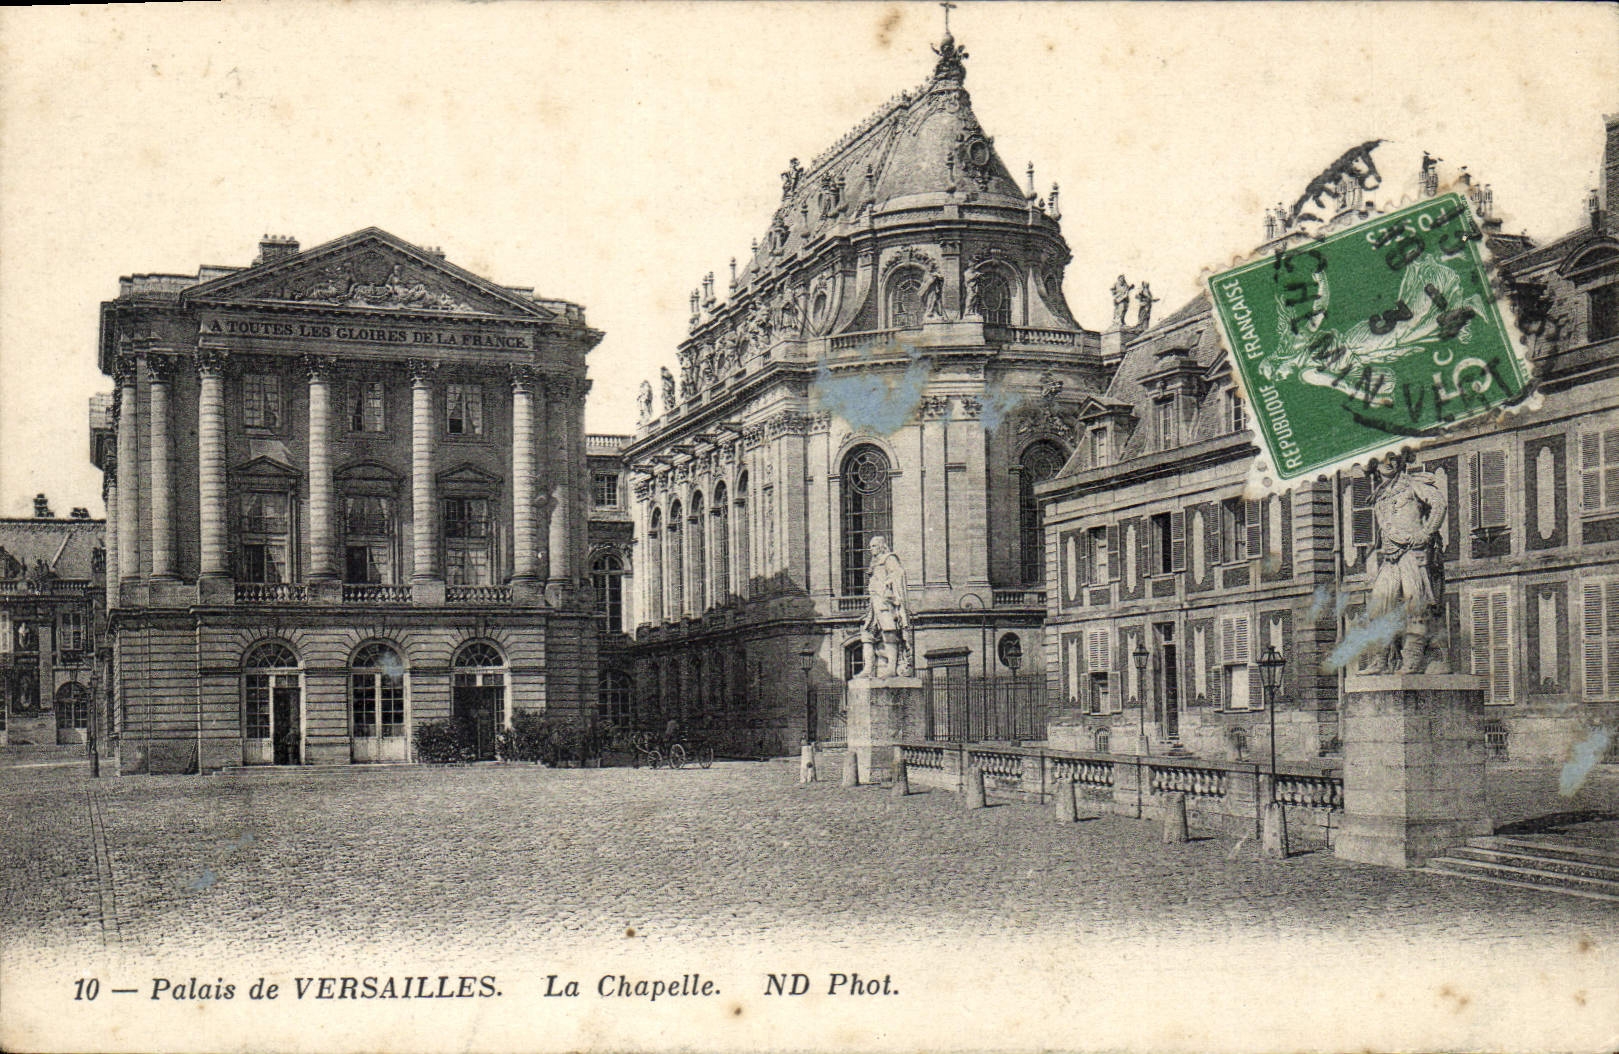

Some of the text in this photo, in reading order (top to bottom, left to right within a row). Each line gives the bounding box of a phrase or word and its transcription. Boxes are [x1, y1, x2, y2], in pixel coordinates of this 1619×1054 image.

[211, 320, 222, 333] A
[227, 320, 294, 335] TOUTES
[299, 324, 332, 338] LES
[336, 327, 407, 342] GLOIRES
[413, 331, 434, 344] DE
[437, 333, 456, 345] LA
[1222, 278, 1304, 470] REPUBLIQUE FRANÇAISE
